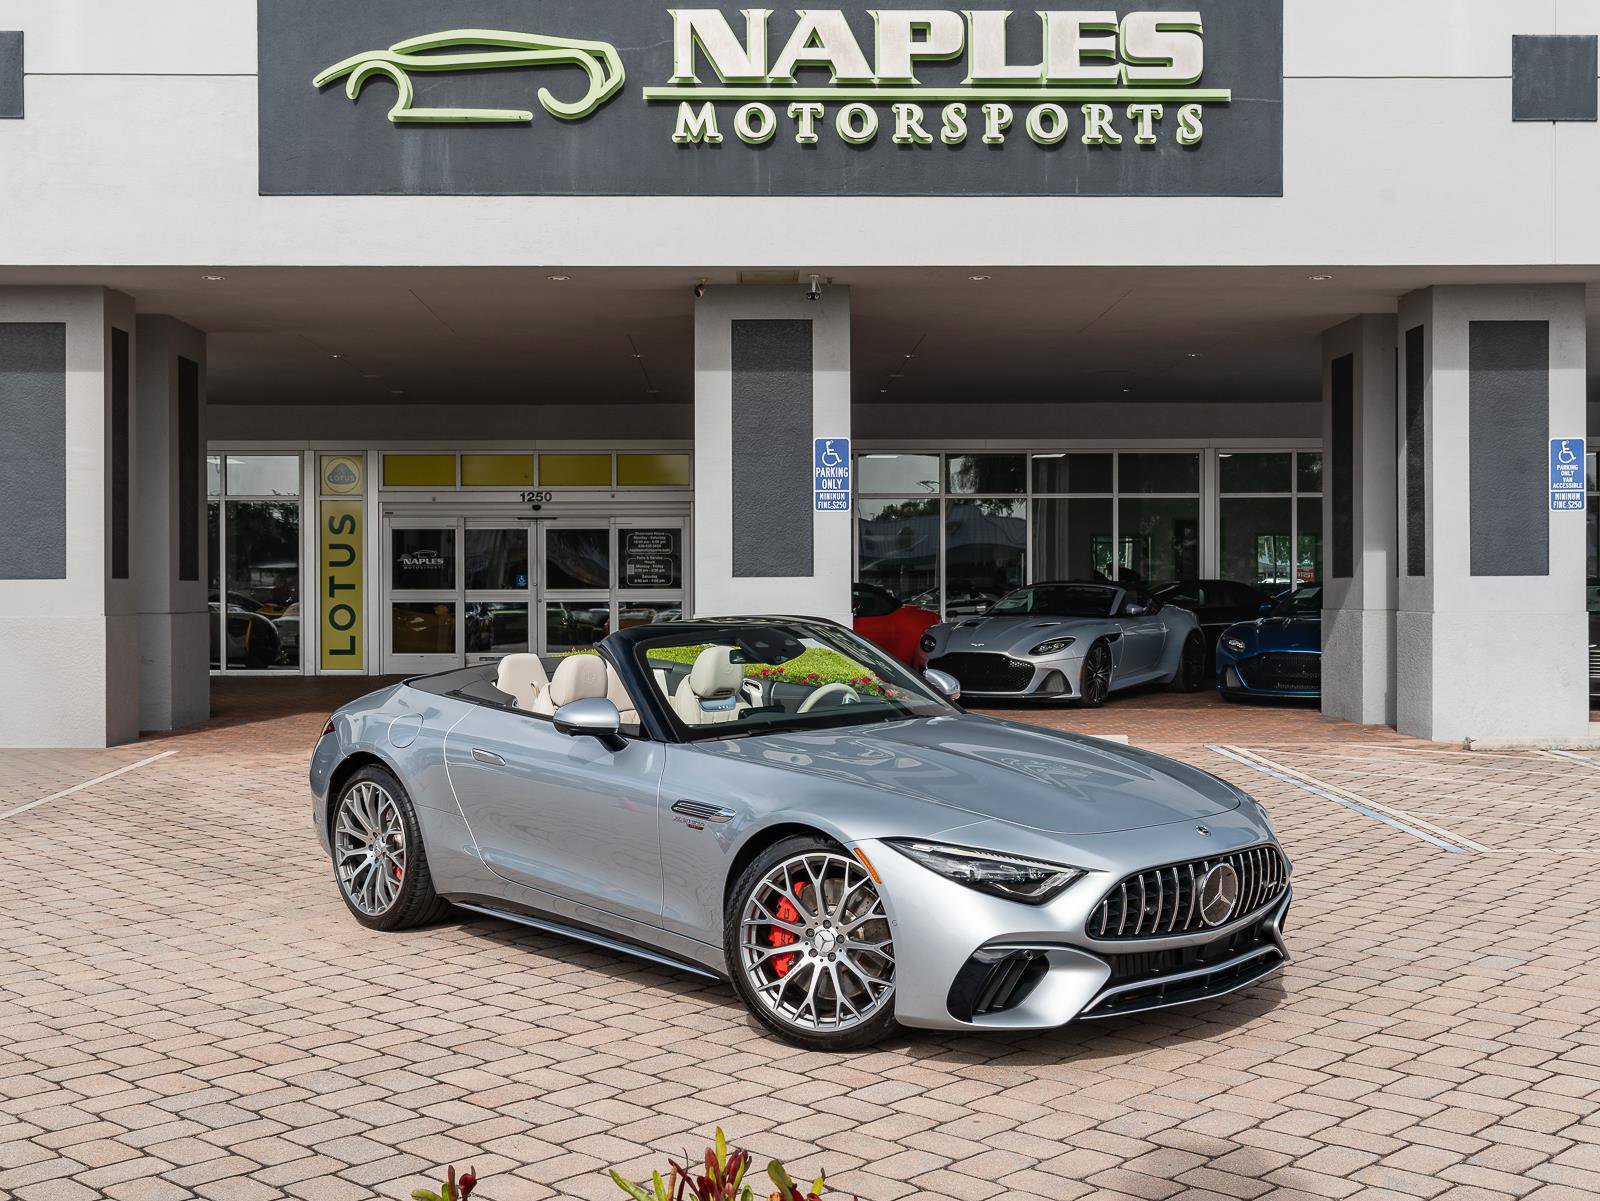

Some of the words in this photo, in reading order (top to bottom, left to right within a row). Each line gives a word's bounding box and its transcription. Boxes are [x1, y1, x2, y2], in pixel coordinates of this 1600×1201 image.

[667, 8, 1204, 86] NAPLES
[672, 101, 1204, 146] MOTORSPORTS
[816, 467, 849, 478] PARKING
[821, 479, 843, 489] ONLY
[520, 491, 552, 503] 1250
[328, 513, 357, 656] LOTUS
